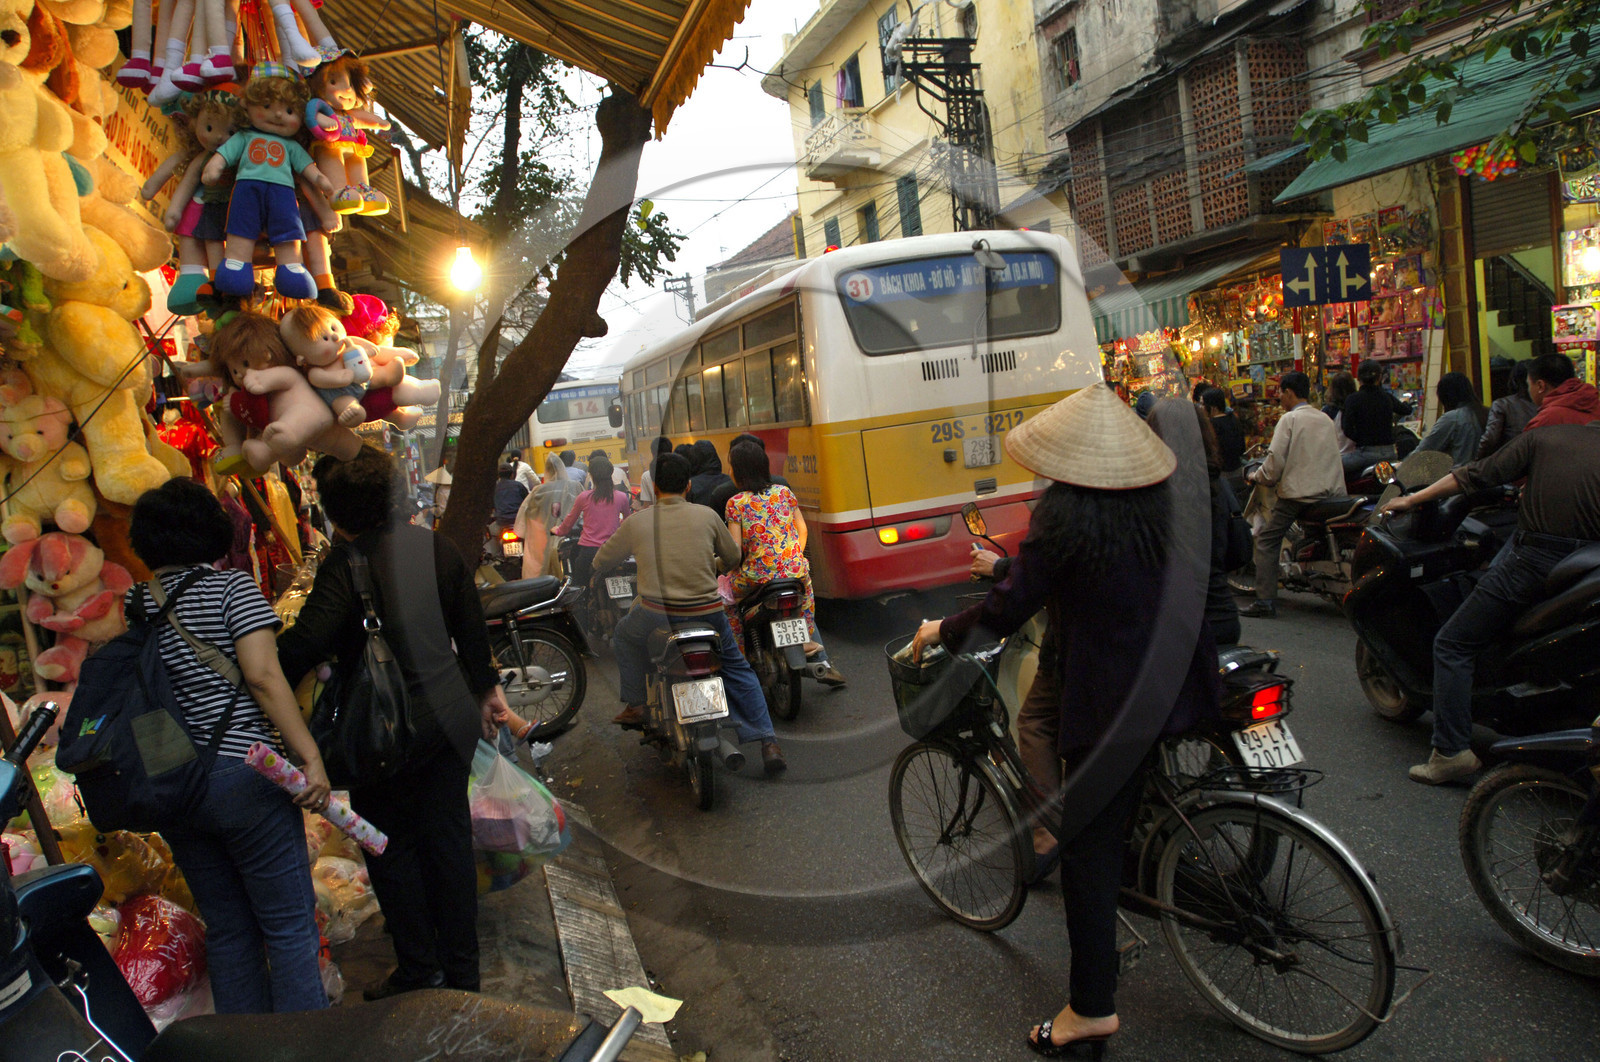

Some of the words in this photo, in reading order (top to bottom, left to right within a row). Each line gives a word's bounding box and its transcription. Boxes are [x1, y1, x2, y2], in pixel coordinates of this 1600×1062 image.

[248, 137, 286, 168] 69
[849, 279, 870, 299] 31
[880, 271, 903, 295] BÁCH
[903, 272, 926, 293] KHOA
[574, 401, 599, 415] 14
[931, 419, 965, 443] 29S
[984, 411, 1024, 434] 8212
[971, 440, 993, 453] 29S
[971, 451, 996, 467] 8212
[775, 619, 804, 634] 29-P2
[778, 631, 806, 645] 2853
[1253, 743, 1297, 767] 2071
